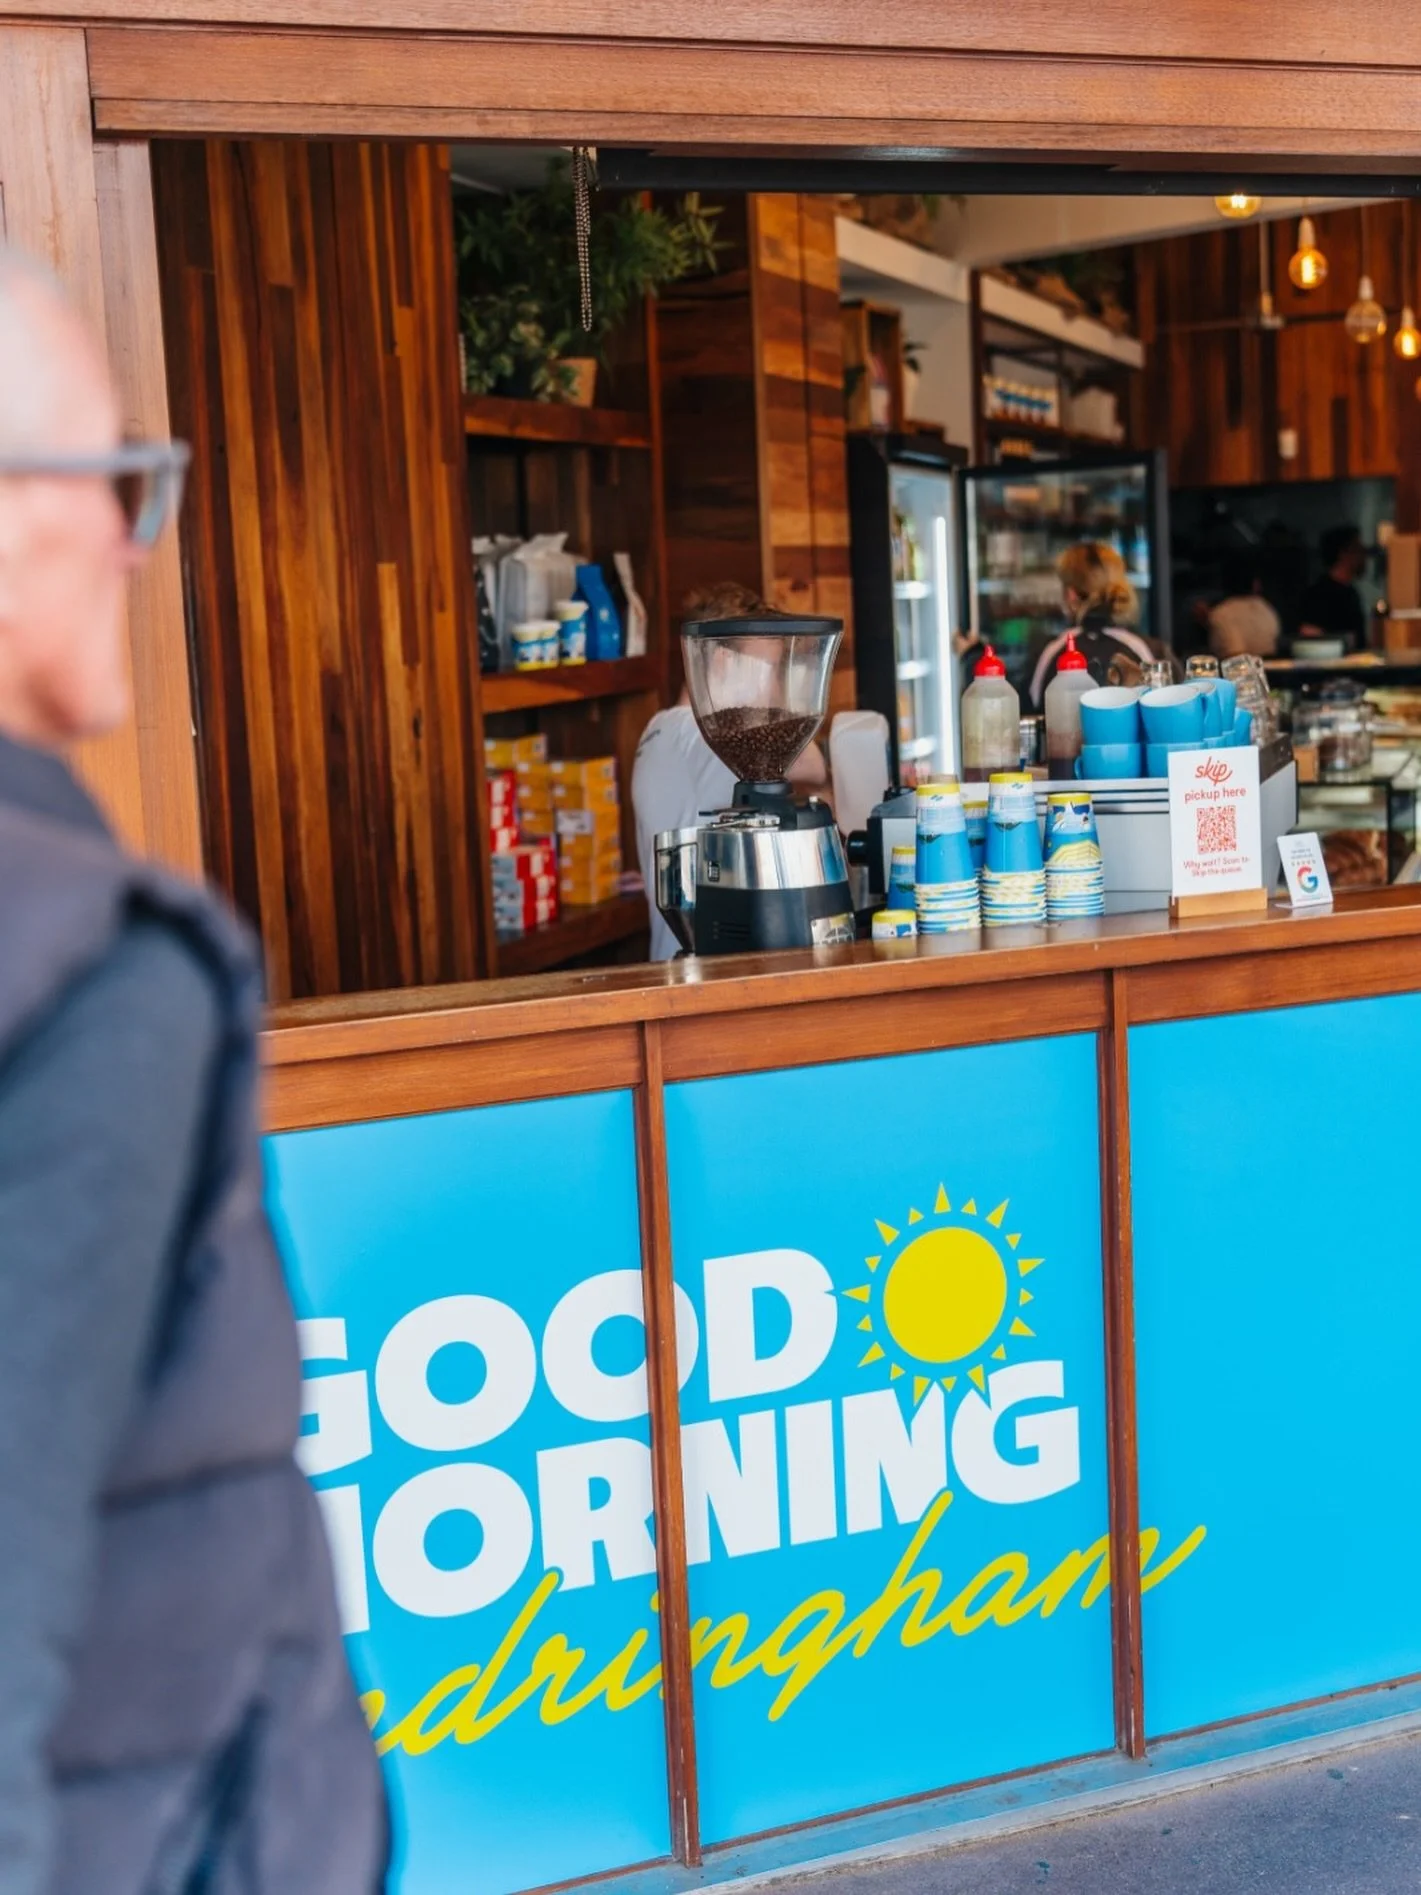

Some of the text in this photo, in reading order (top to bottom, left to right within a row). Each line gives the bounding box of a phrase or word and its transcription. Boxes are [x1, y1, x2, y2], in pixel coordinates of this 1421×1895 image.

[1195, 756, 1233, 787] skip
[1184, 787, 1246, 804] pickup here
[312, 1360, 1081, 1635] ORNING
